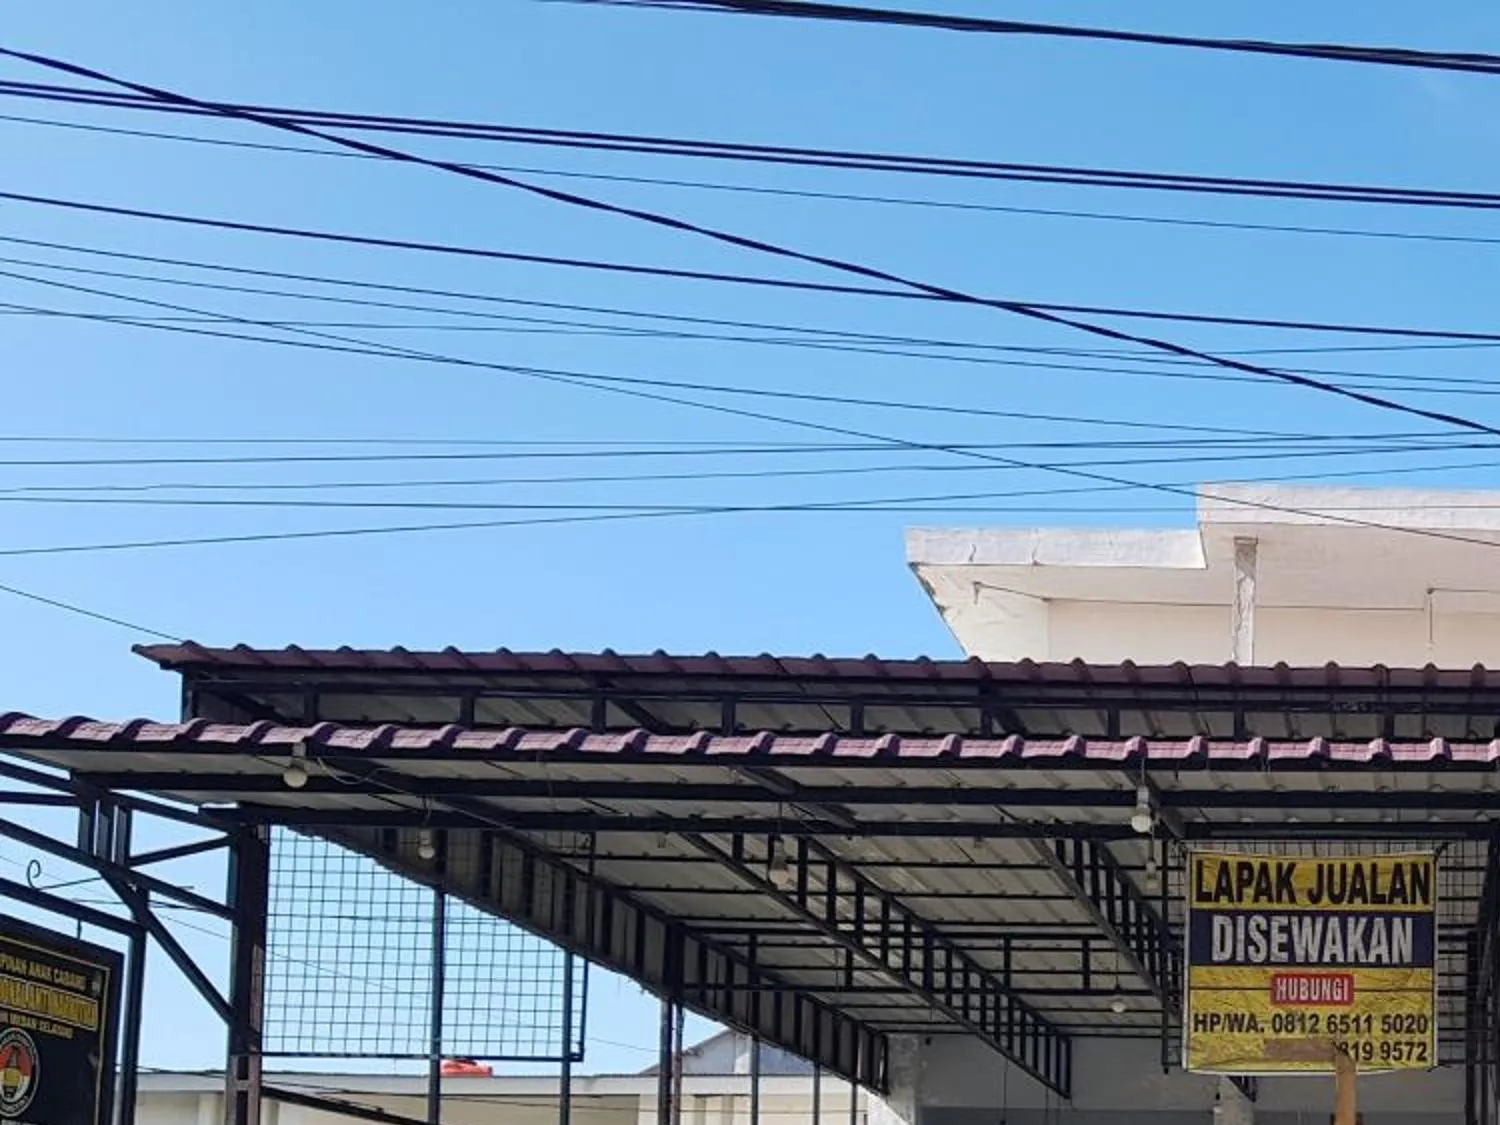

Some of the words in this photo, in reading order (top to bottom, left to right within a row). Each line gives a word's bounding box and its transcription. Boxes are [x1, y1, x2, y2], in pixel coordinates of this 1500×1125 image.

[1195, 860, 1298, 904] LAPAK
[1307, 861, 1430, 905] JUALAN
[1211, 915, 1414, 964] DISEWAKAN
[1276, 977, 1349, 1001] HUBUNGI
[1193, 1013, 1265, 1034] HP/WA.
[1271, 1013, 1319, 1034] 0812
[1326, 1014, 1372, 1034] 6511
[1381, 1014, 1428, 1035] 5020
[1335, 1040, 1374, 1061] 819
[1380, 1041, 1428, 1062] 9572
